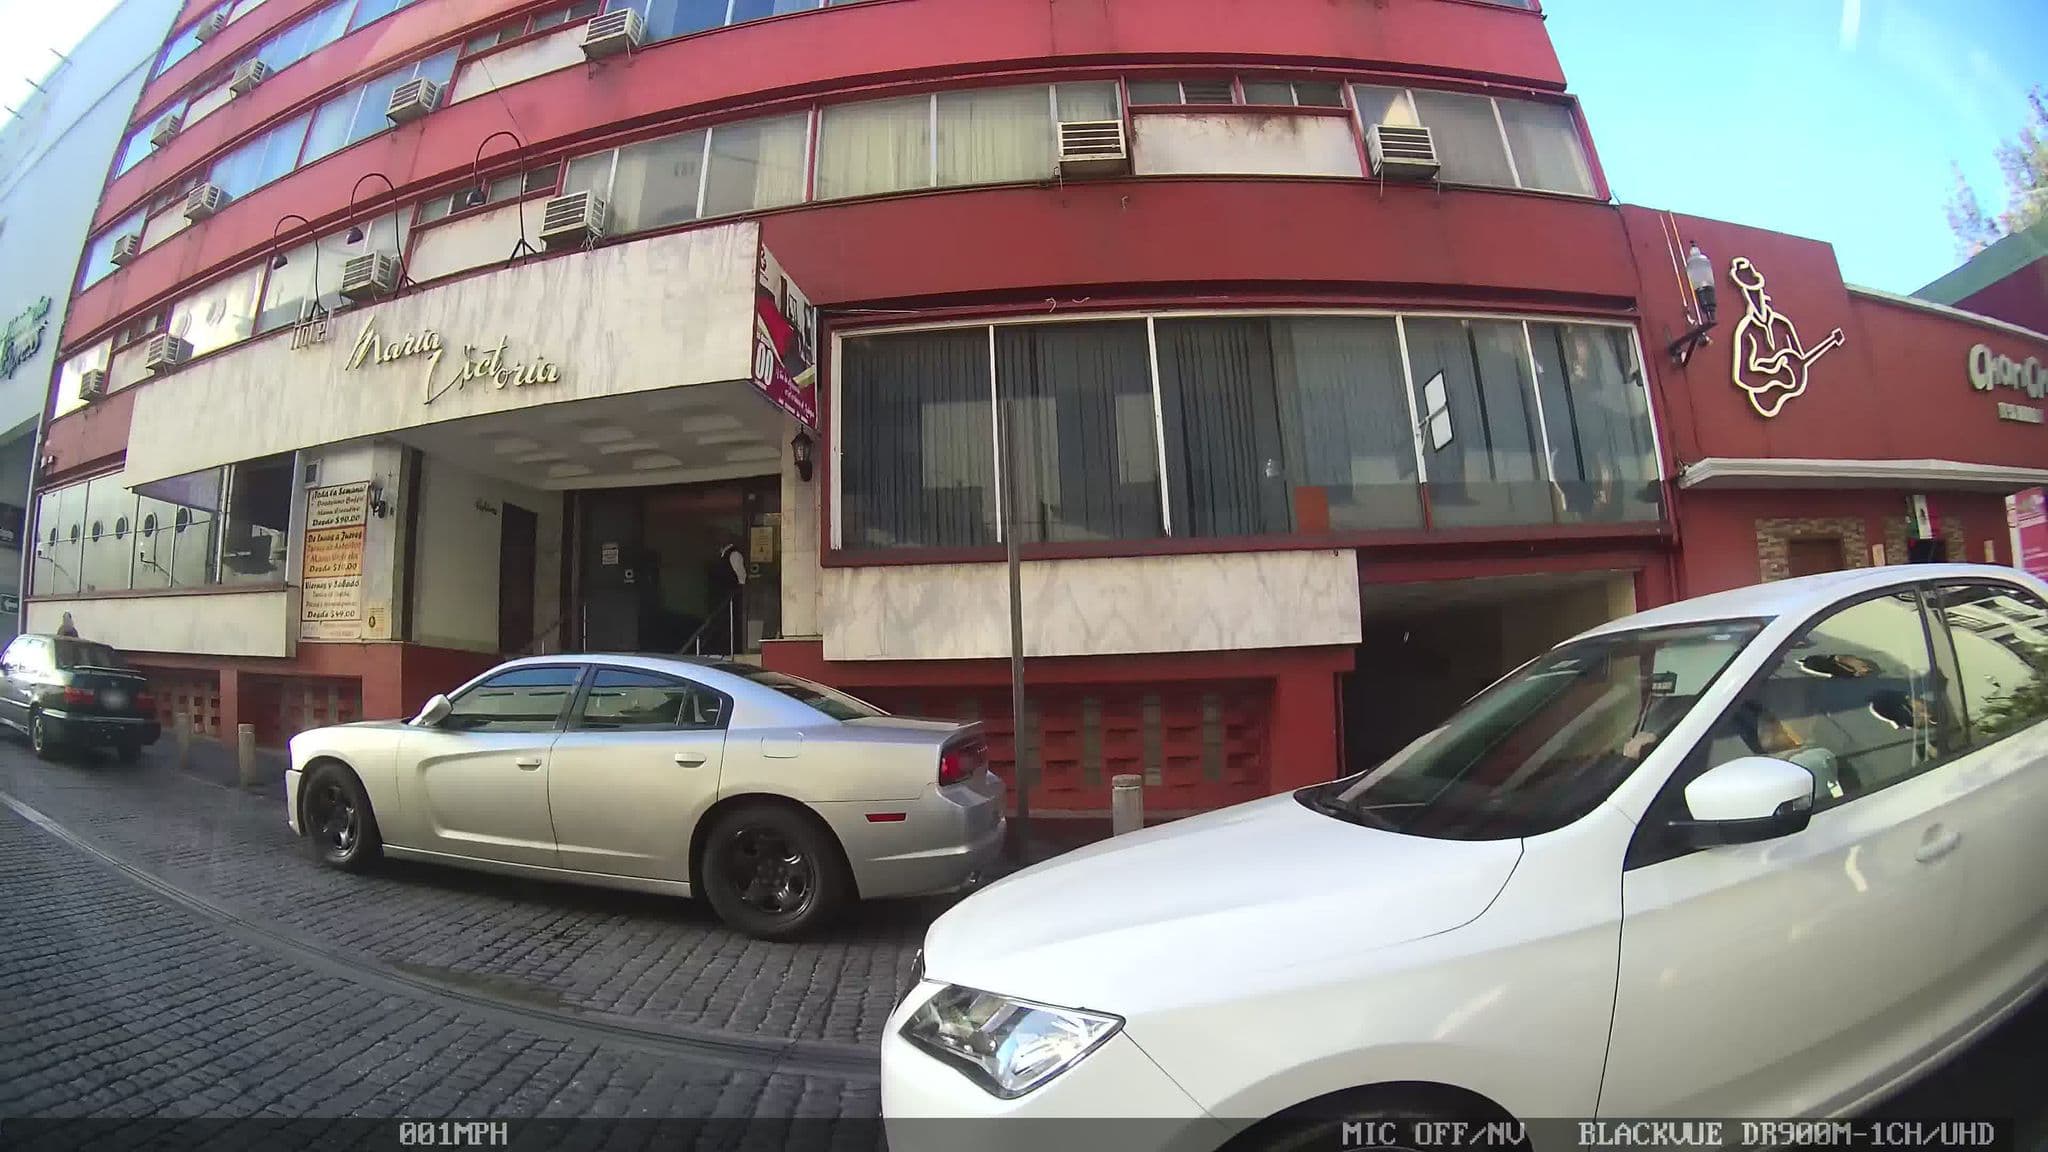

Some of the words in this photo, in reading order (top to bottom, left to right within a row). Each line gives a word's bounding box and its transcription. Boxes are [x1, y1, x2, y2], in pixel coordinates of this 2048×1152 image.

[290, 297, 333, 350] Hotel
[423, 335, 561, 405] Victoria
[308, 534, 317, 543] De
[309, 565, 331, 573] Desde
[305, 581, 327, 589] Viernes
